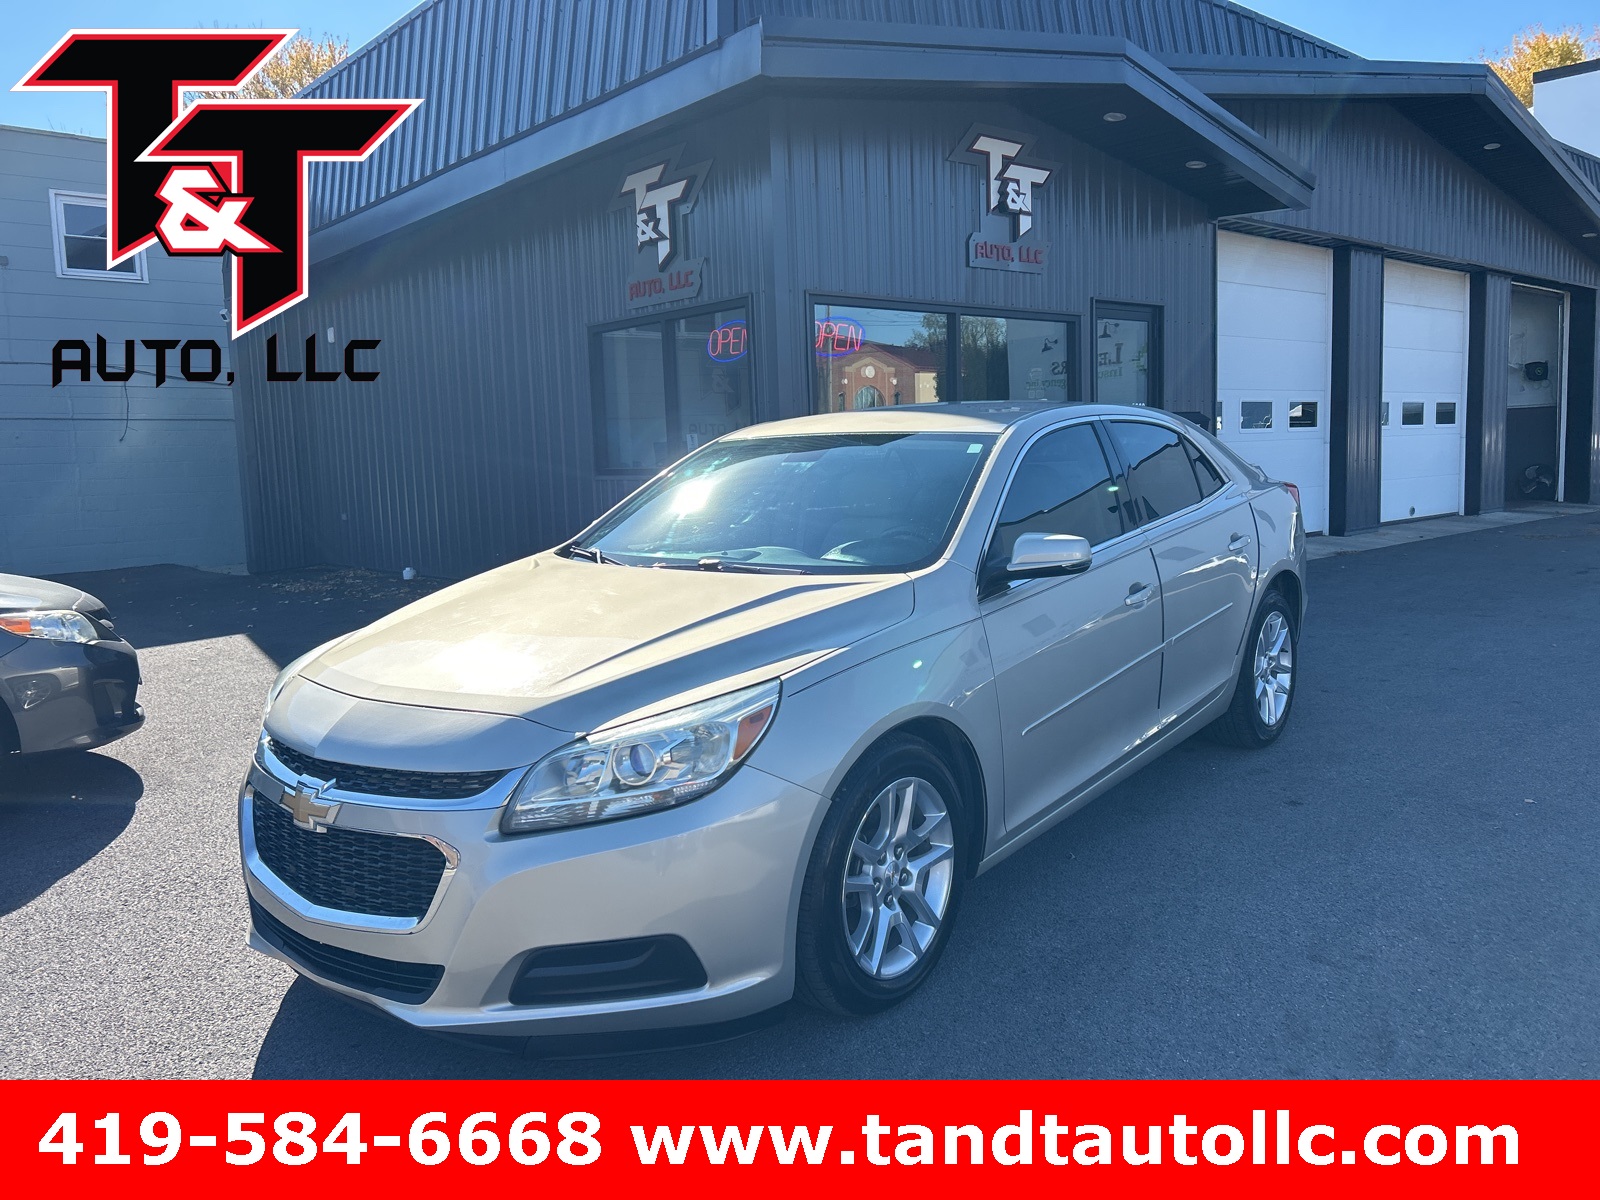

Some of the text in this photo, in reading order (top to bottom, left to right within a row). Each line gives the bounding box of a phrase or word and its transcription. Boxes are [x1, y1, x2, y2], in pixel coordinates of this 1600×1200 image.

[975, 241, 1045, 264] AUTO, LLC
[629, 270, 694, 300] AUTO, LLC
